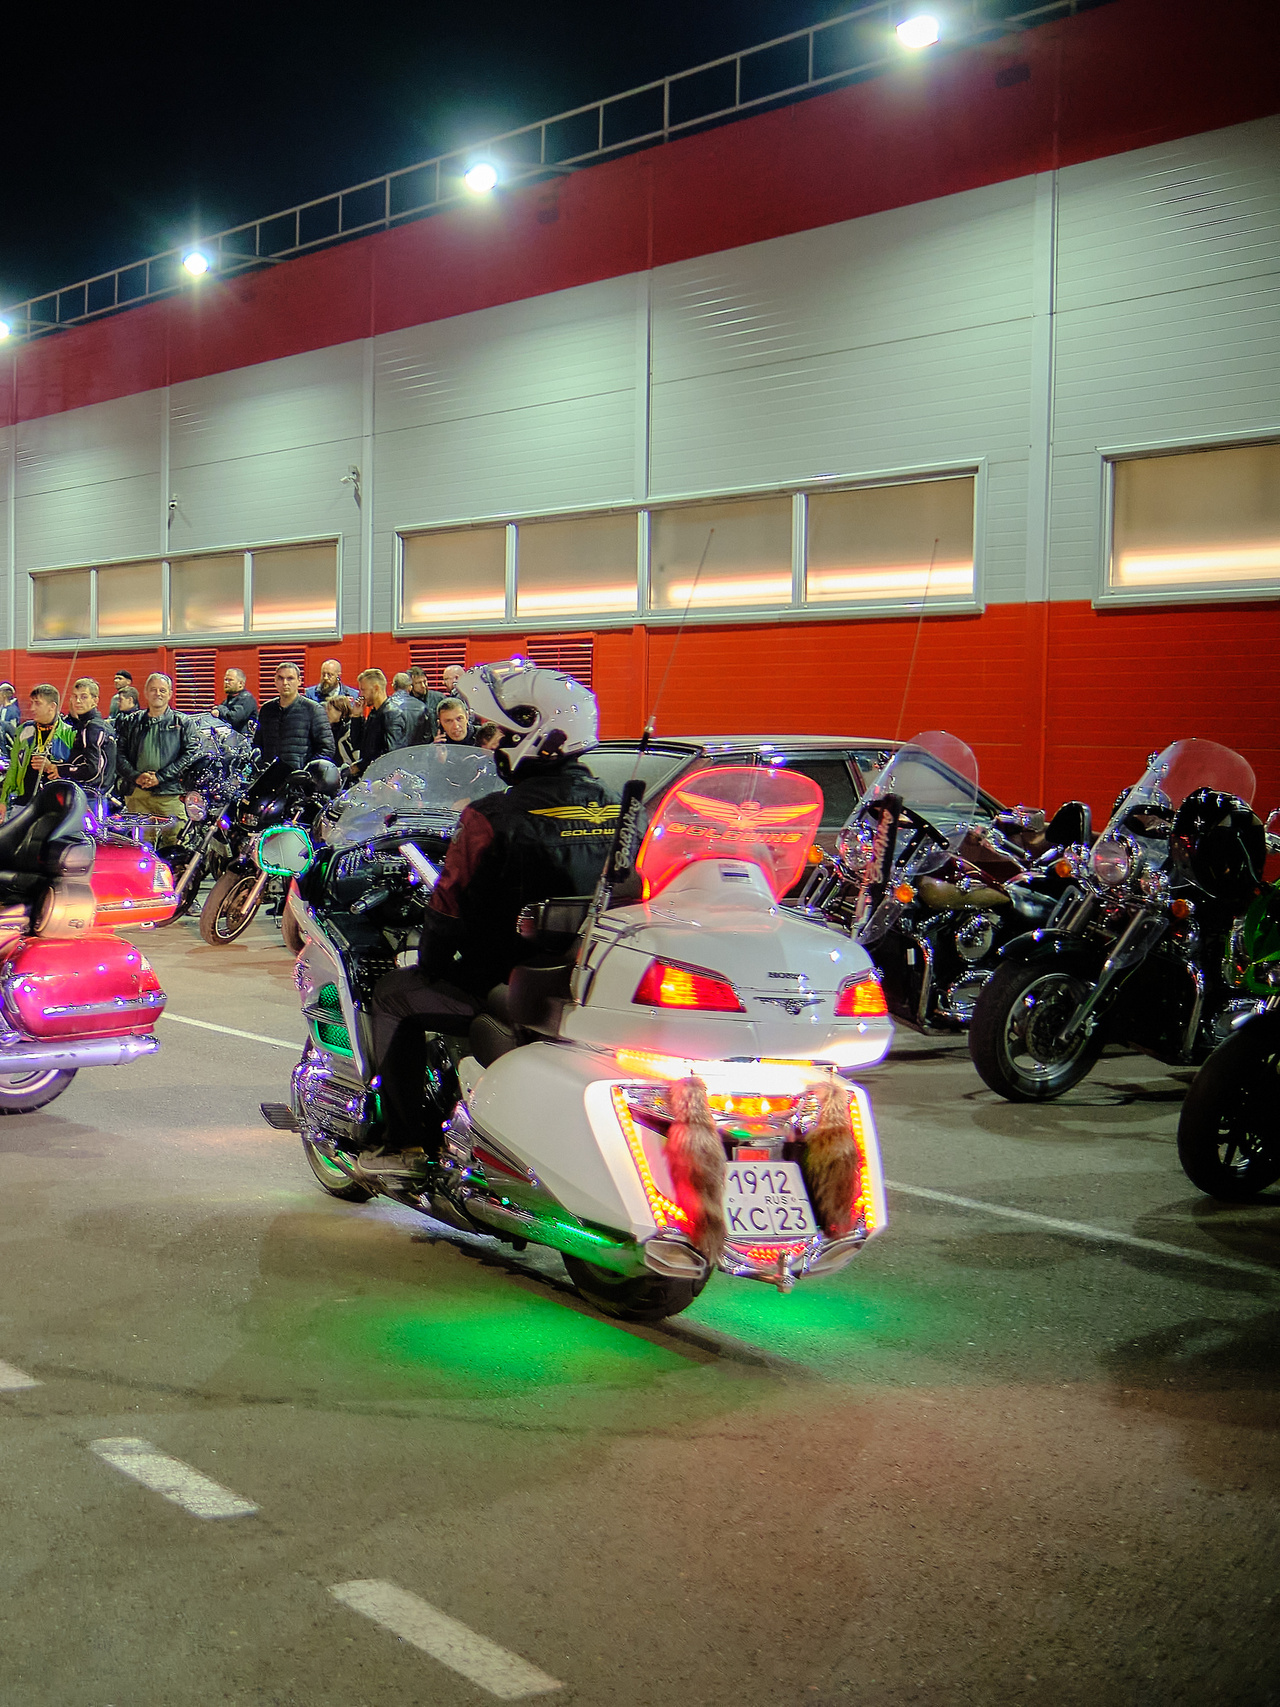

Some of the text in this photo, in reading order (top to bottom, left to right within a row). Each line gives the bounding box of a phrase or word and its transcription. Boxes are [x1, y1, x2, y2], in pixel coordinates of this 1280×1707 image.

[666, 822, 803, 844] GOLDWING
[728, 1169, 791, 1194] 1912
[764, 1195, 789, 1205] RUS
[727, 1207, 807, 1231] KC 23
